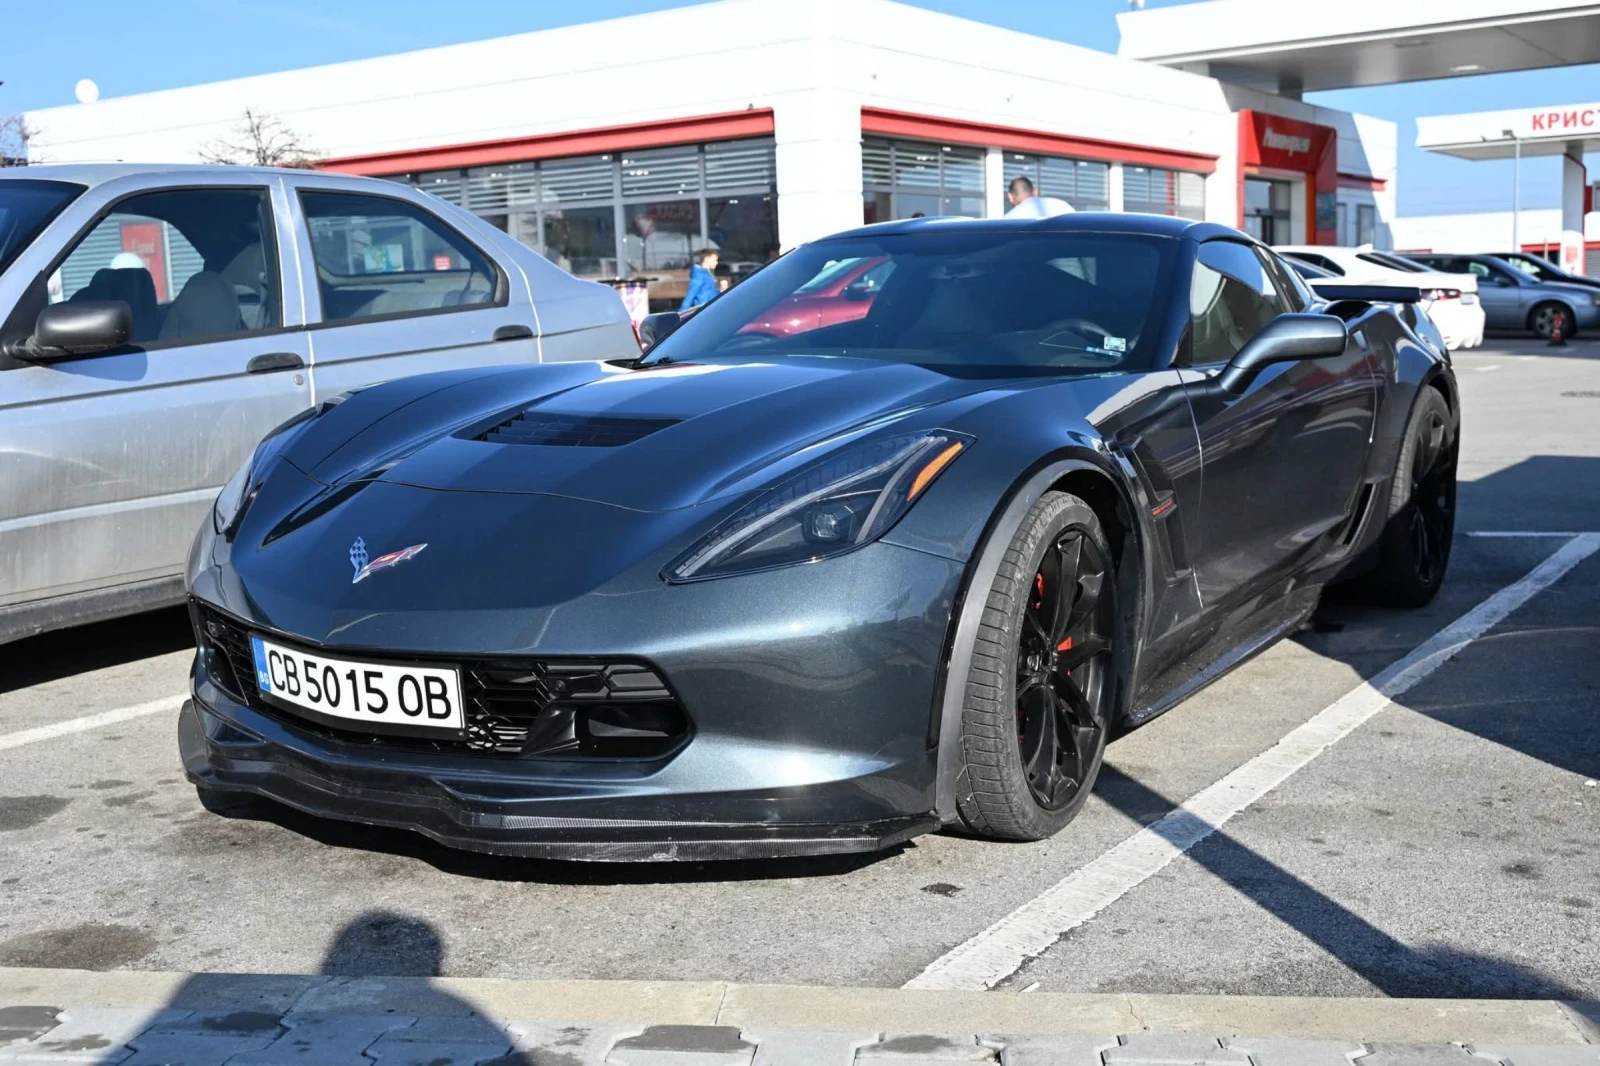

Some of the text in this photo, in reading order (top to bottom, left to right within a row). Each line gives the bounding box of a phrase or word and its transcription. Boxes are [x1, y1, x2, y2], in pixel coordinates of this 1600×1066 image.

[1532, 109, 1600, 131] КРИС
[258, 670, 270, 685] BG
[397, 674, 452, 720] OB
